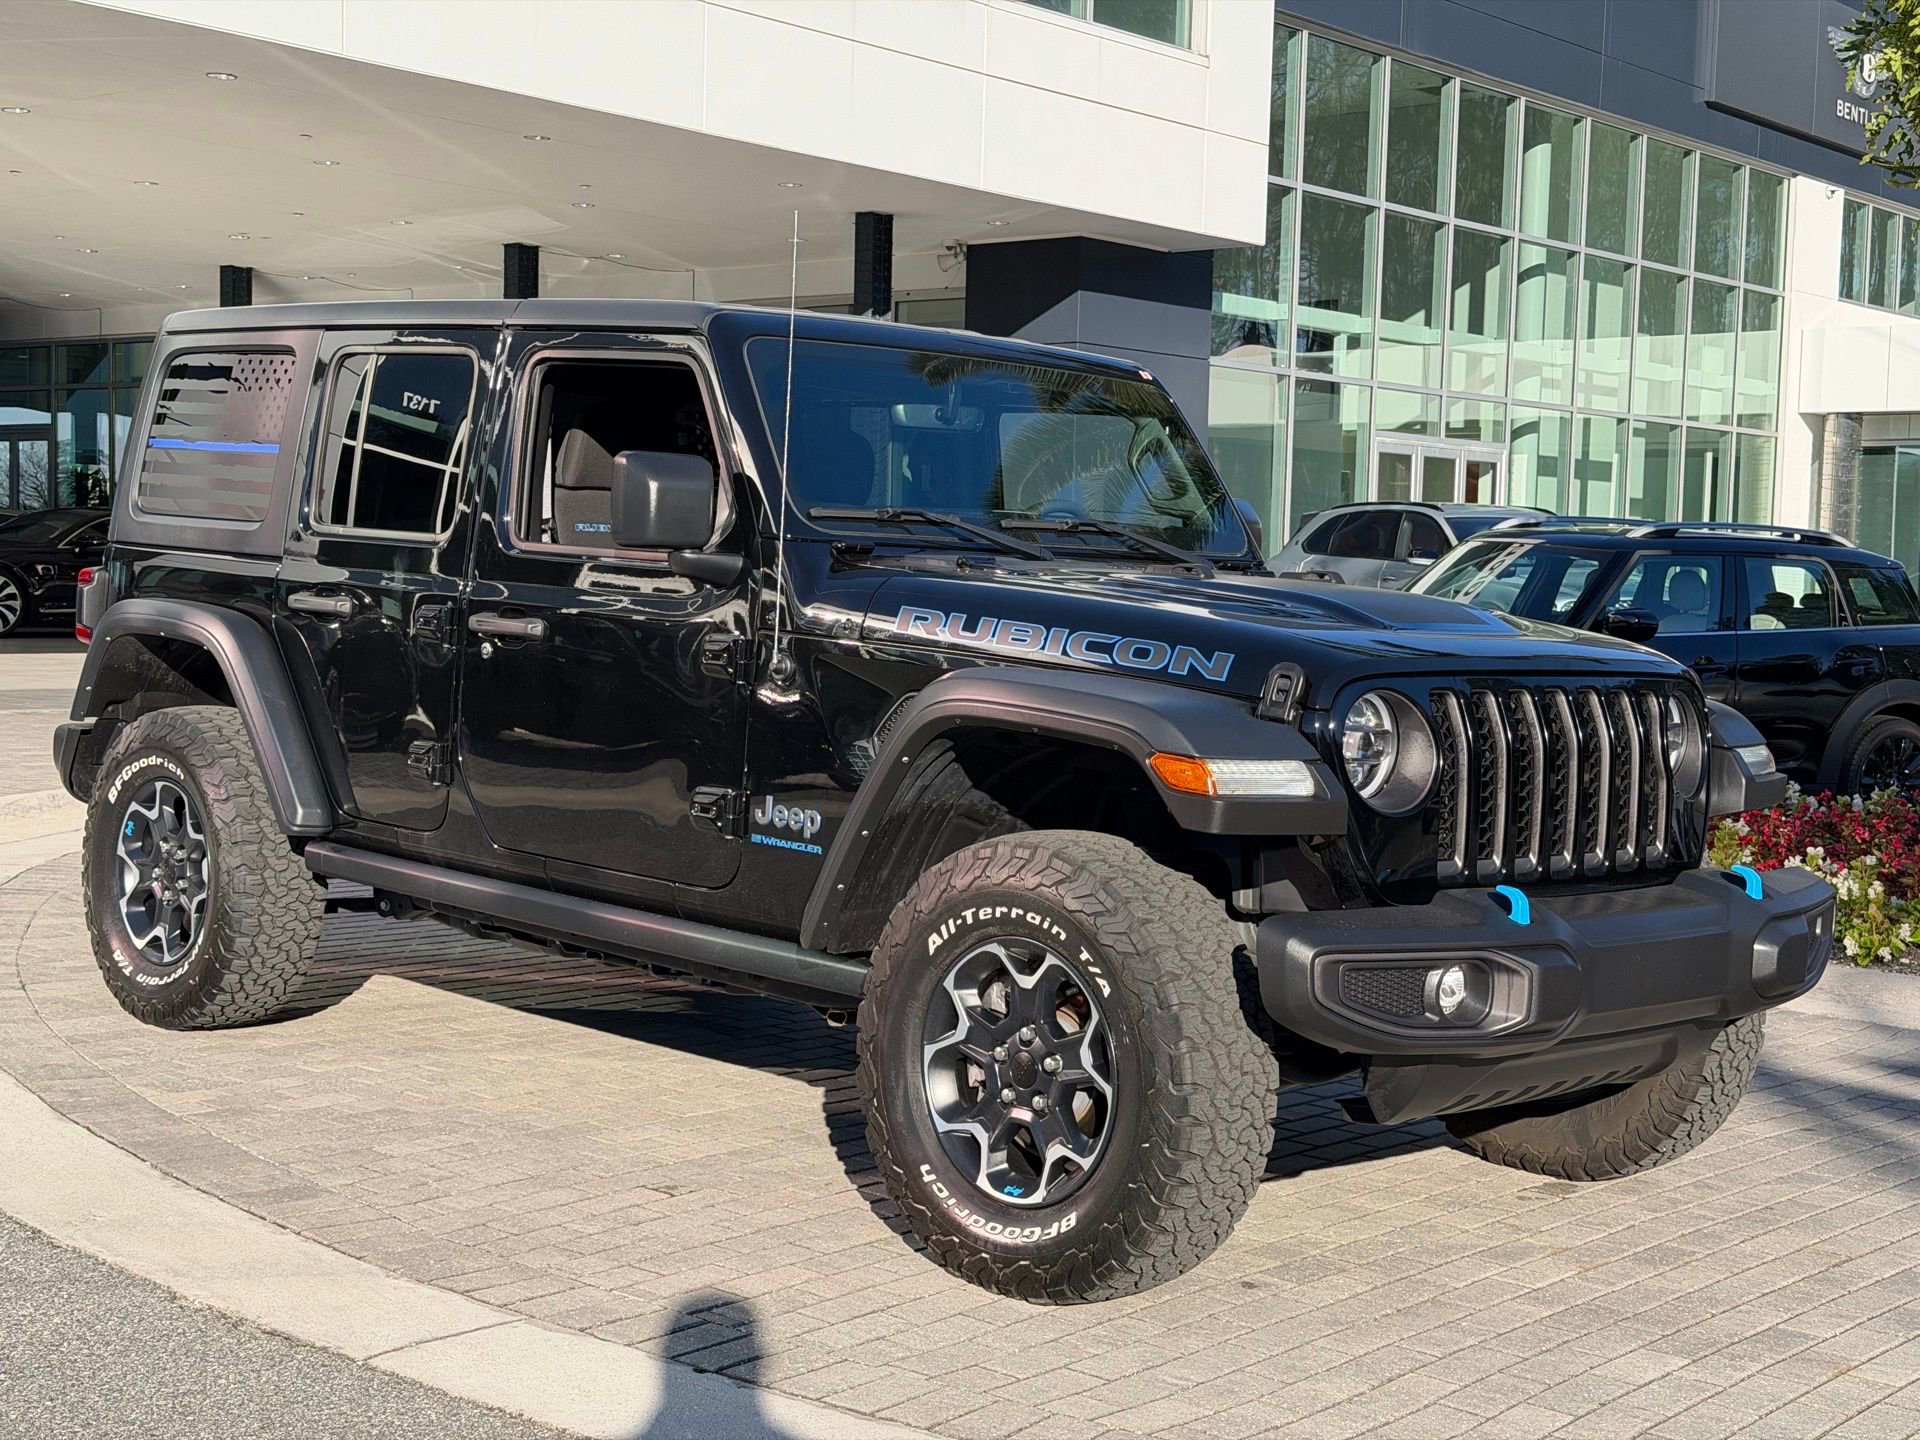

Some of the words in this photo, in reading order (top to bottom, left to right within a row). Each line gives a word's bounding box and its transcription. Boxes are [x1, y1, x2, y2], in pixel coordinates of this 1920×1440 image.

[574, 523, 611, 533] RUBI
[894, 605, 1235, 682] RUBICON
[108, 755, 184, 804] BFGoodrich
[755, 795, 821, 839] Jeep
[761, 835, 823, 855] WRANGLER
[112, 949, 134, 977] T/A
[928, 906, 1067, 956] All-Terrain
[1078, 946, 1112, 999] T/A
[919, 1163, 1078, 1243] BFGoodrich
